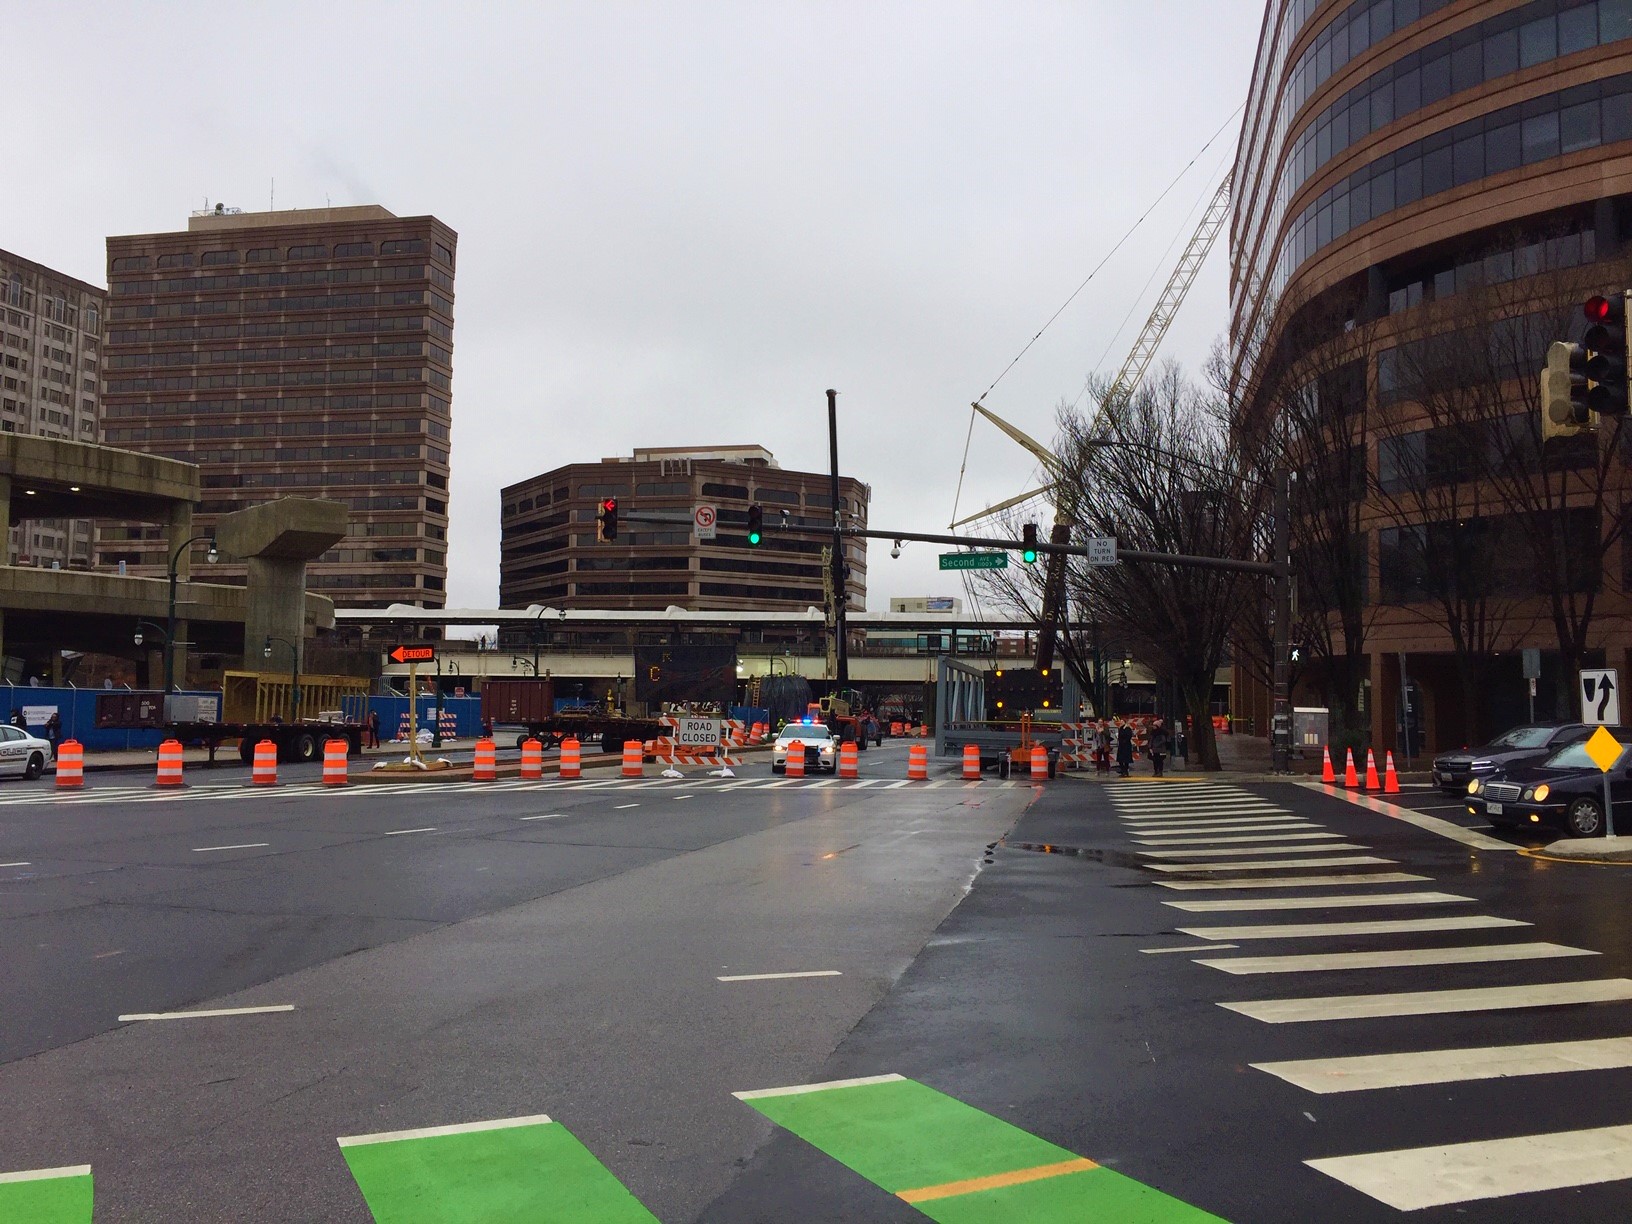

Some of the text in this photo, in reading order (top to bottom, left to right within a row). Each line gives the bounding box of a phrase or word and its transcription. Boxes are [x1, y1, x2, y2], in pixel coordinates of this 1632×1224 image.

[941, 558, 975, 567] Second
[687, 722, 712, 730] ROAD
[682, 733, 717, 742] CLOSED
[0, 747, 27, 756] OLICE
